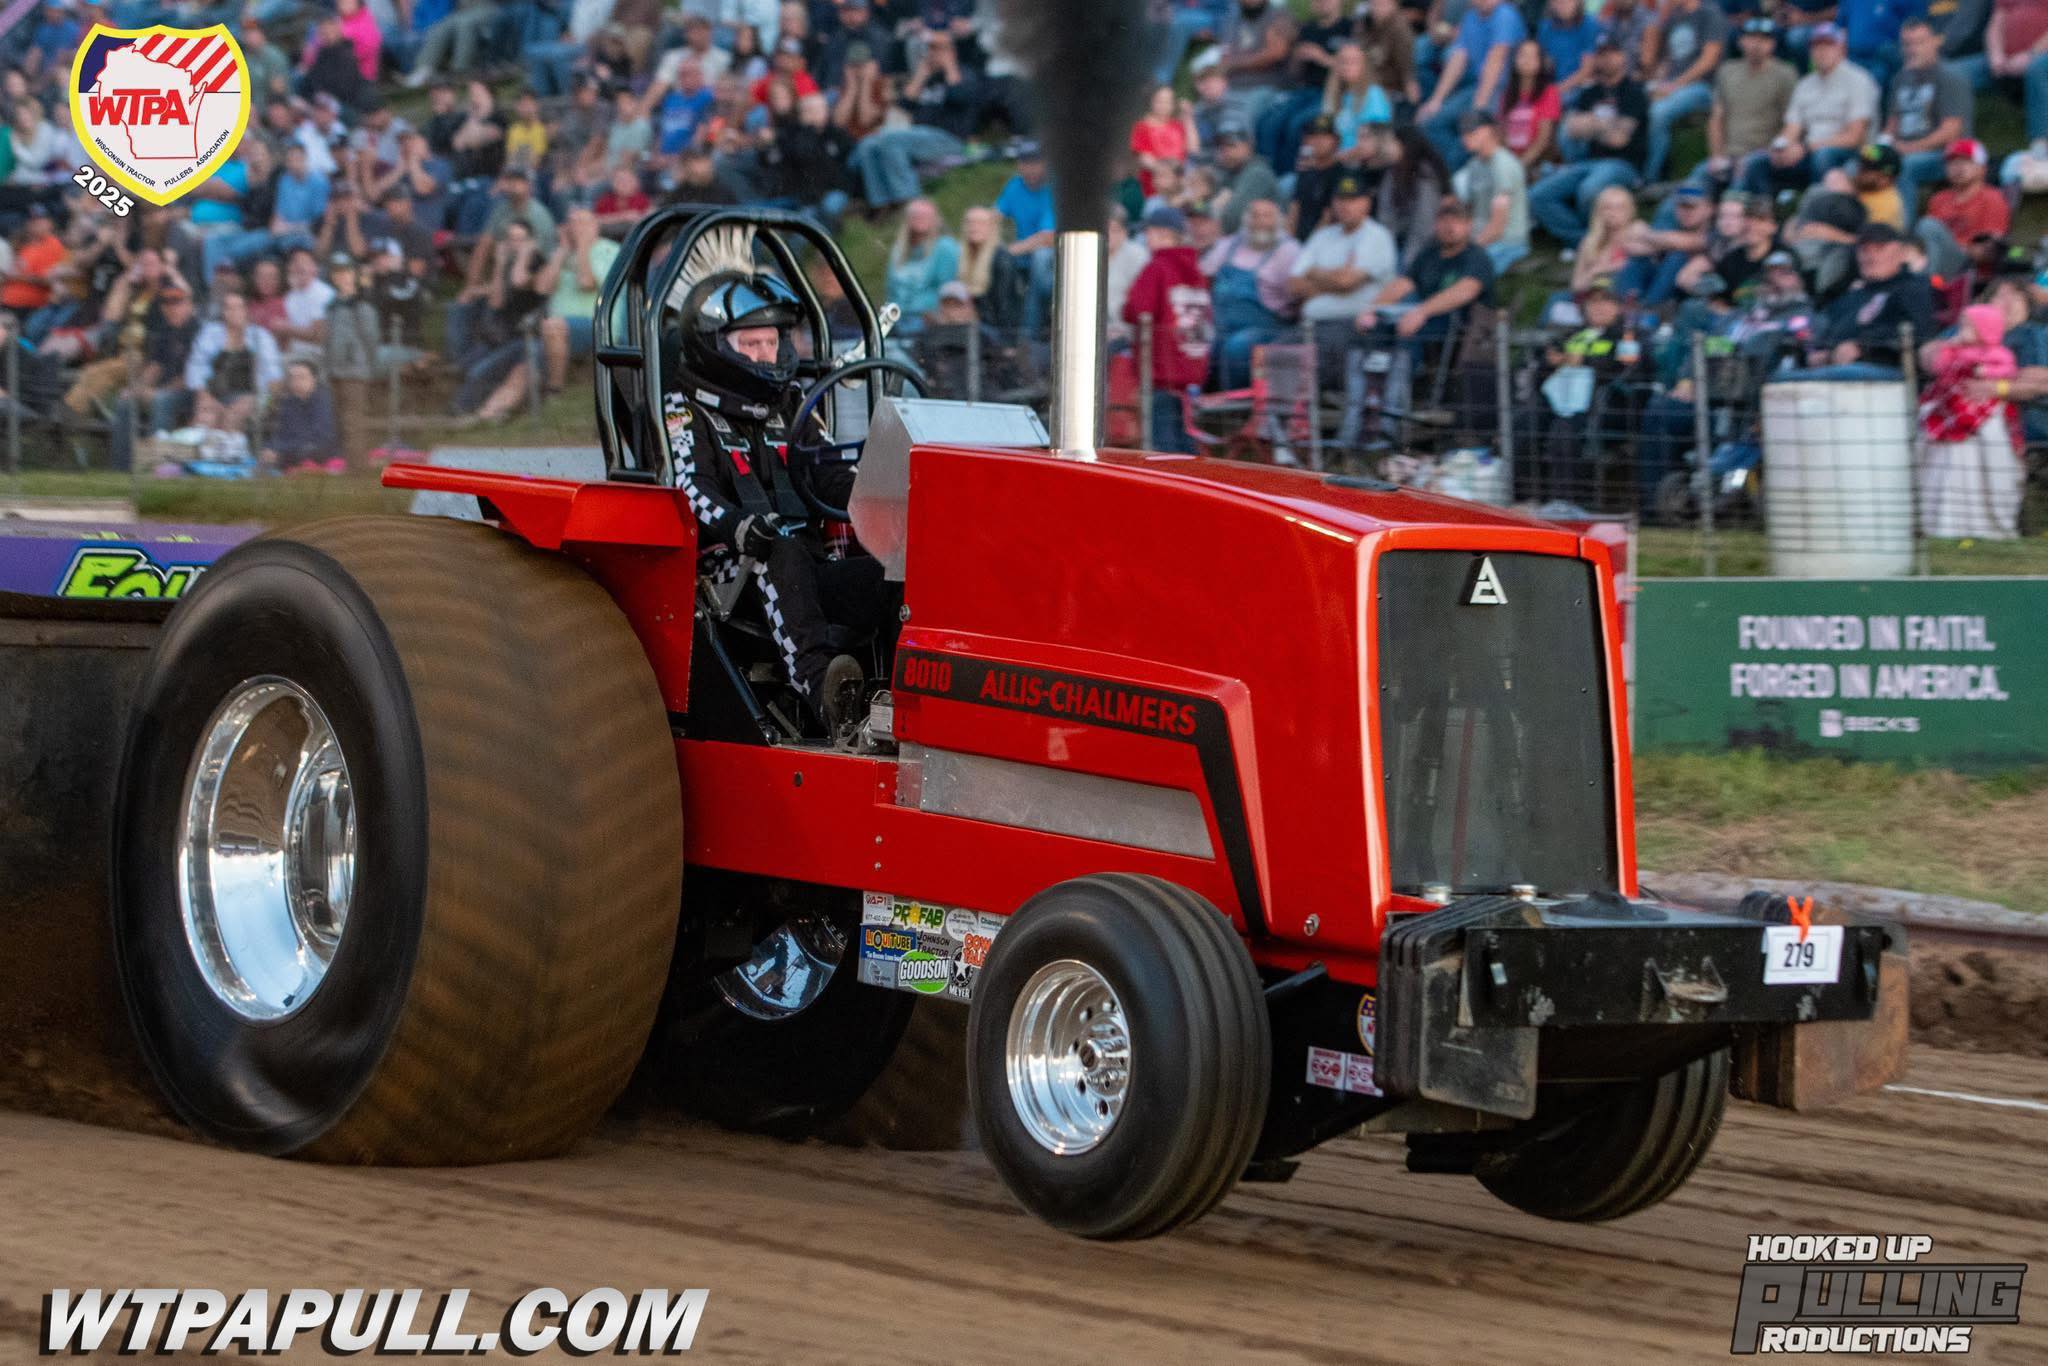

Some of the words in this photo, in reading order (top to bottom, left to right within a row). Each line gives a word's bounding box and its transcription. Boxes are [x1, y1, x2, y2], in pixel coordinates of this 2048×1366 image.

[1738, 615, 1865, 651] FOUNDED
[1868, 615, 1901, 651] IN
[1904, 615, 1997, 652] FAITH.
[1730, 662, 1837, 698] FORGED
[1839, 663, 1872, 699] IN
[1873, 664, 2009, 701] AMERICA.
[903, 657, 952, 693] 8010
[979, 669, 1199, 737] ALLIS-CHALMERS
[917, 930, 951, 946] JOHNSON
[917, 942, 949, 956] TRACTOR
[1783, 942, 1815, 968] 279
[899, 959, 949, 980] GOODSON
[948, 984, 970, 998] MEYER
